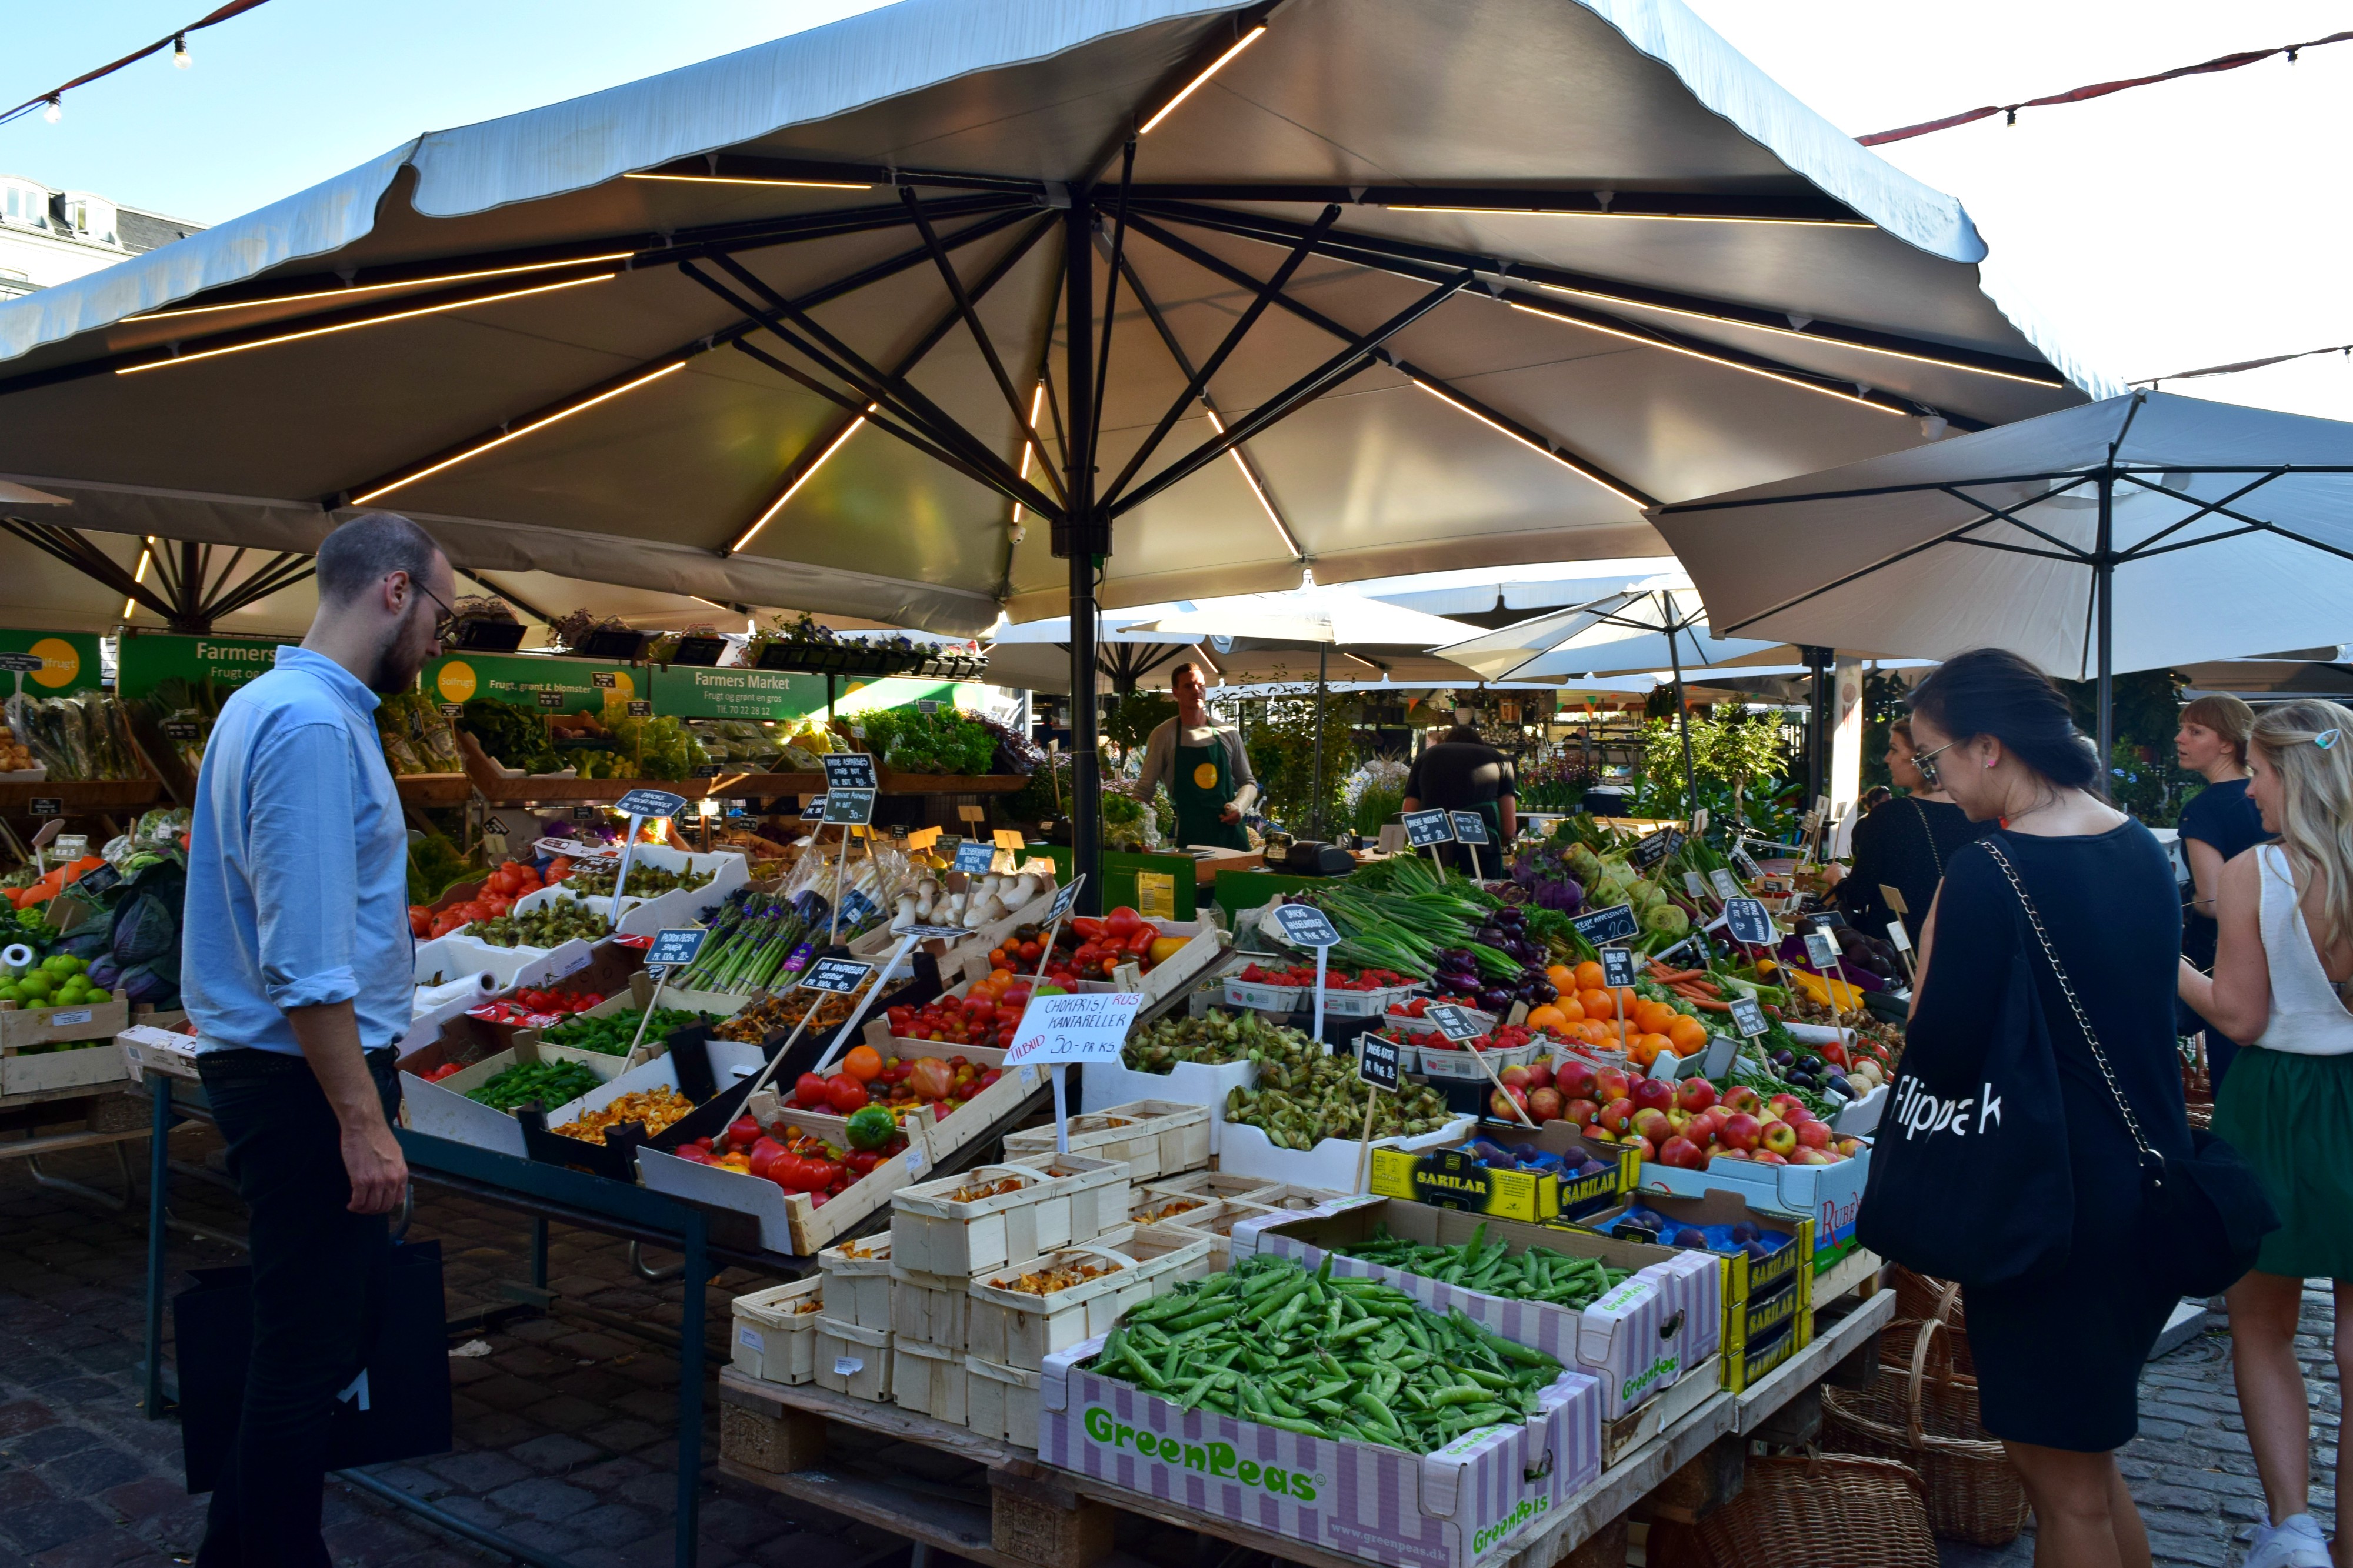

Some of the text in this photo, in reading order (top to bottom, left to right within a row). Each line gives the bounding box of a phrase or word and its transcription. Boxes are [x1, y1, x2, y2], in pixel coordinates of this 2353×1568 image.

[196, 642, 275, 662] Farmers
[43, 658, 76, 670] lfrugt
[211, 666, 242, 680] Frugt
[695, 672, 790, 690] Farmers Market
[441, 677, 474, 688] Solfrugt
[489, 680, 592, 695] Frugt, grønt & blomster
[704, 691, 723, 701] Frugt
[736, 693, 755, 703] grønt
[767, 695, 782, 703] gros
[717, 705, 770, 715] Tlf. 70 22 28 12
[641, 792, 666, 800] DANSKE
[1574, 906, 1629, 930] RESSE APPELSINER
[818, 962, 832, 970] LUX
[1112, 993, 1141, 1005] RUS
[1048, 1013, 1126, 1029] KANTARELLER
[1008, 1035, 1045, 1062] TILBUD
[1082, 1042, 1094, 1052] PR
[1417, 1171, 1487, 1195] SARILAR
[1562, 1171, 1616, 1206] SARILAR
[1751, 1247, 1796, 1289] SARILAR
[1602, 1283, 1647, 1312] GreenPeas
[1748, 1293, 1794, 1336] SARILAR
[1084, 1406, 1317, 1502] GreenPeas
[1331, 1523, 1446, 1562] www.greenpeas.dk
